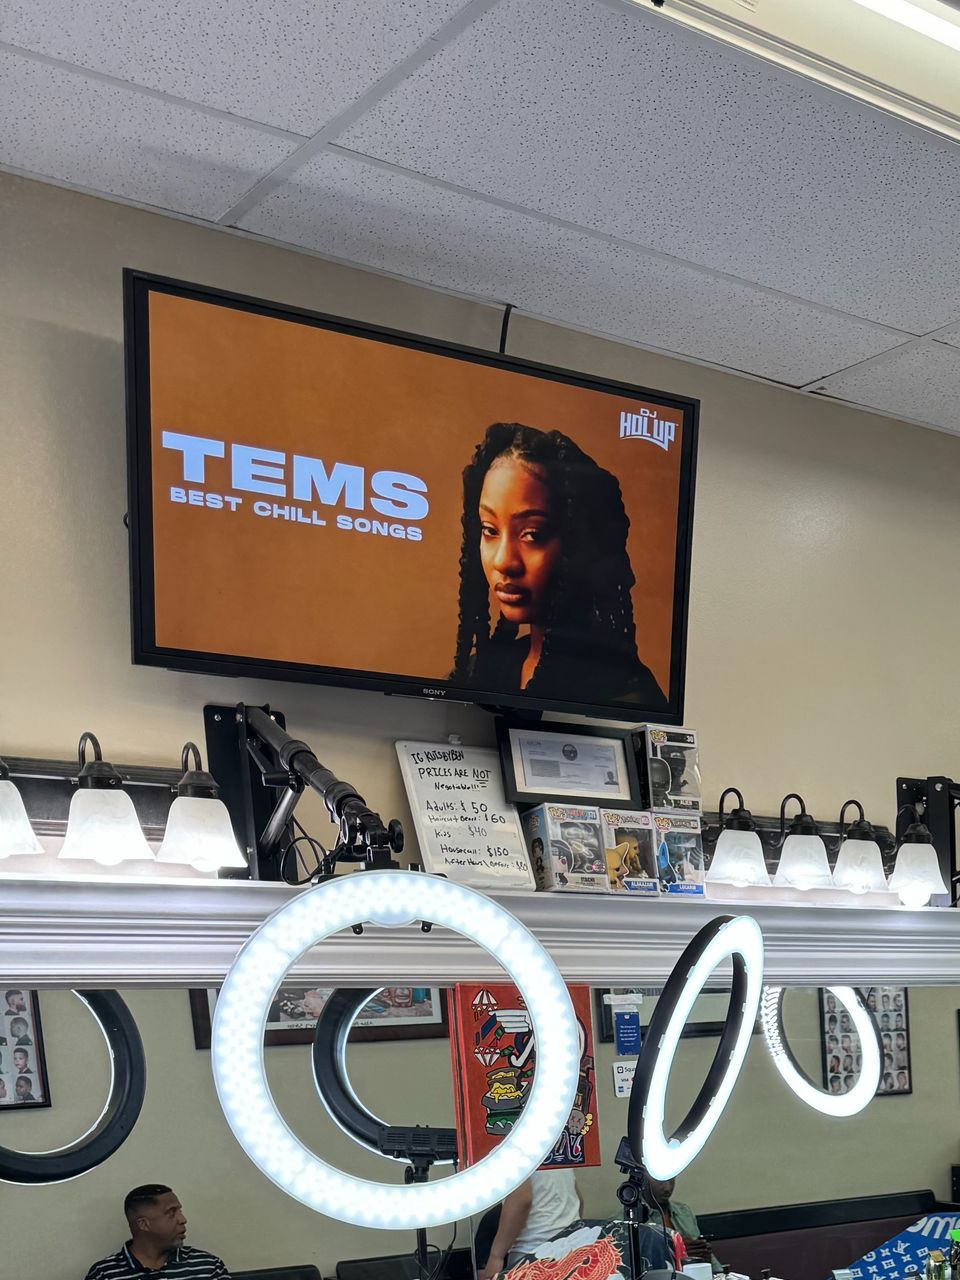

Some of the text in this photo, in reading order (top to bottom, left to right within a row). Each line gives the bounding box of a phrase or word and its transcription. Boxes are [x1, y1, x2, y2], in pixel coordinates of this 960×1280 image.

[640, 408, 657, 418] DJ
[162, 431, 429, 520] TEMS
[170, 487, 422, 541] BEST CHILL SONGS
[423, 688, 446, 696] SONY
[418, 767, 492, 779] PRICES ARE NOT
[487, 845, 510, 858] $150
